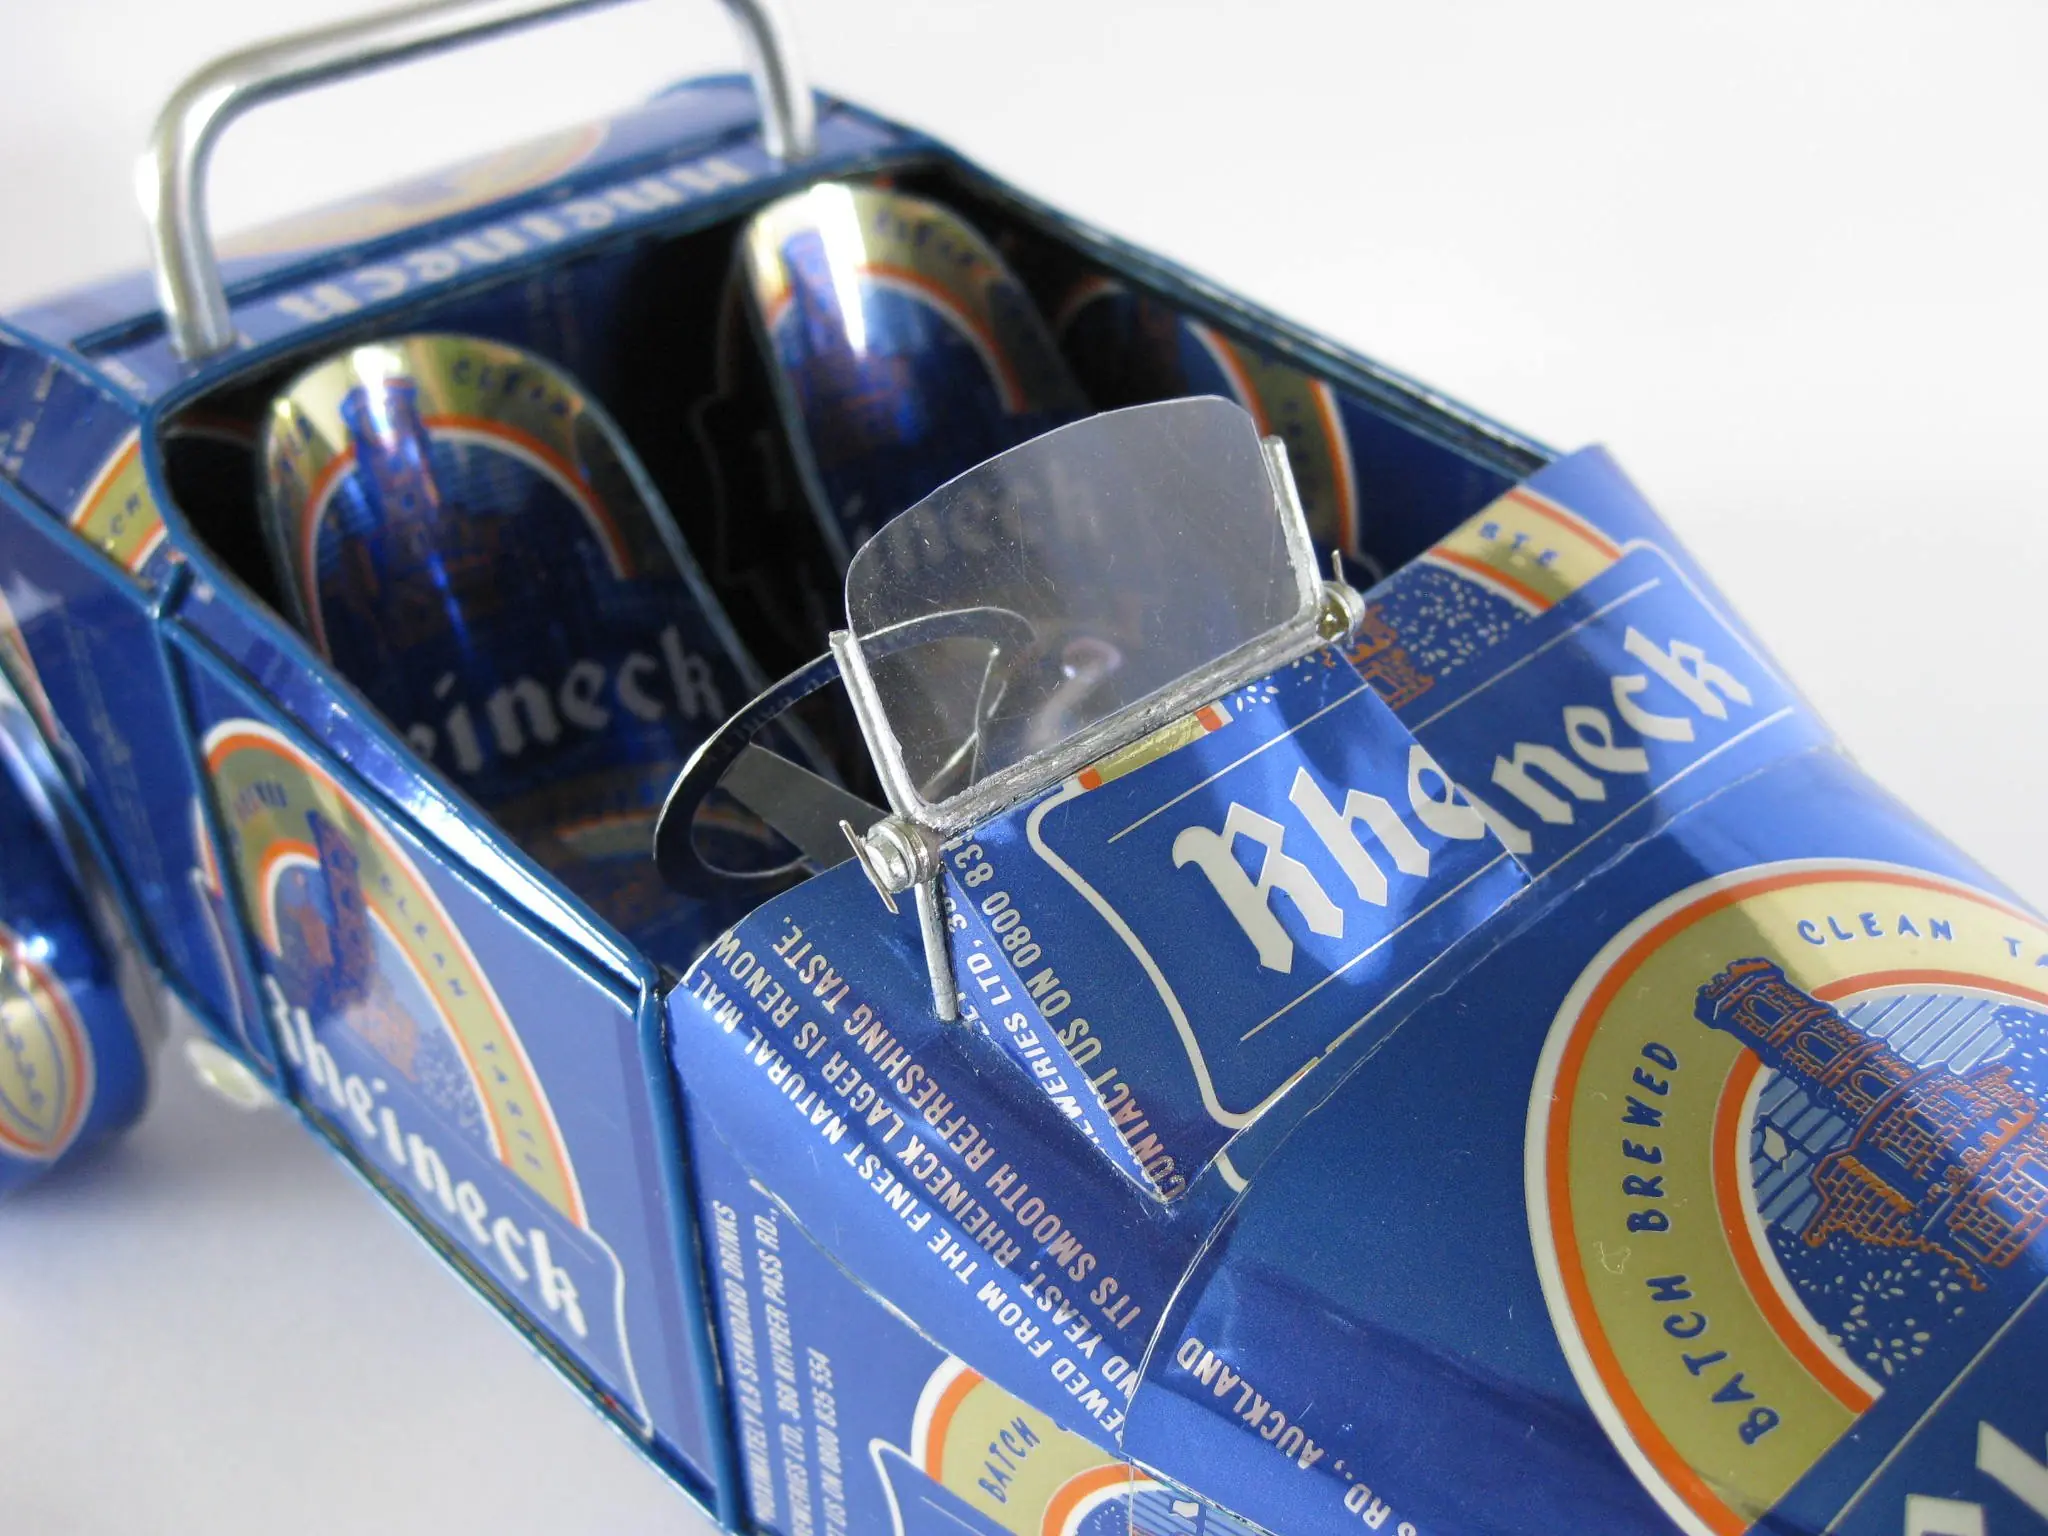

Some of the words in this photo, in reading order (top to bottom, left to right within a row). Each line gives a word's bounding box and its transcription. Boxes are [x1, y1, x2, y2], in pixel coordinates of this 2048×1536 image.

[773, 916, 850, 1014] TASTE.
[981, 891, 1042, 968] 0800
[1796, 911, 1953, 946] CLEAN
[715, 930, 799, 1028] RENOW
[966, 939, 1012, 1006] LTD,
[1026, 967, 1071, 1018] ON
[793, 1021, 827, 1059] IS
[1058, 1018, 1102, 1066] US
[744, 1026, 848, 1145] NATURAL
[821, 1051, 904, 1143] LAGER
[843, 1003, 995, 1172] REFRESHING
[1621, 1042, 1680, 1233] BREWED
[754, 1207, 780, 1251] RD.,
[843, 1142, 932, 1233] FINEST
[896, 1135, 1021, 1269] RHEINECK
[985, 1163, 1096, 1282] SMOOTH
[712, 1199, 744, 1280] DRINKS
[757, 1248, 787, 1306] PASS
[926, 1228, 978, 1285] THE
[975, 1279, 1053, 1358] FROM
[1019, 1260, 1103, 1360] YEAST,
[1090, 1276, 1141, 1330] ITS
[1050, 1357, 1125, 1442] EWED
[1645, 1274, 1781, 1446] BATCH
[1176, 1337, 1325, 1470] AUCKLAND
[977, 1416, 1041, 1504] BATCH
[1334, 1459, 1391, 1530] RD.,
